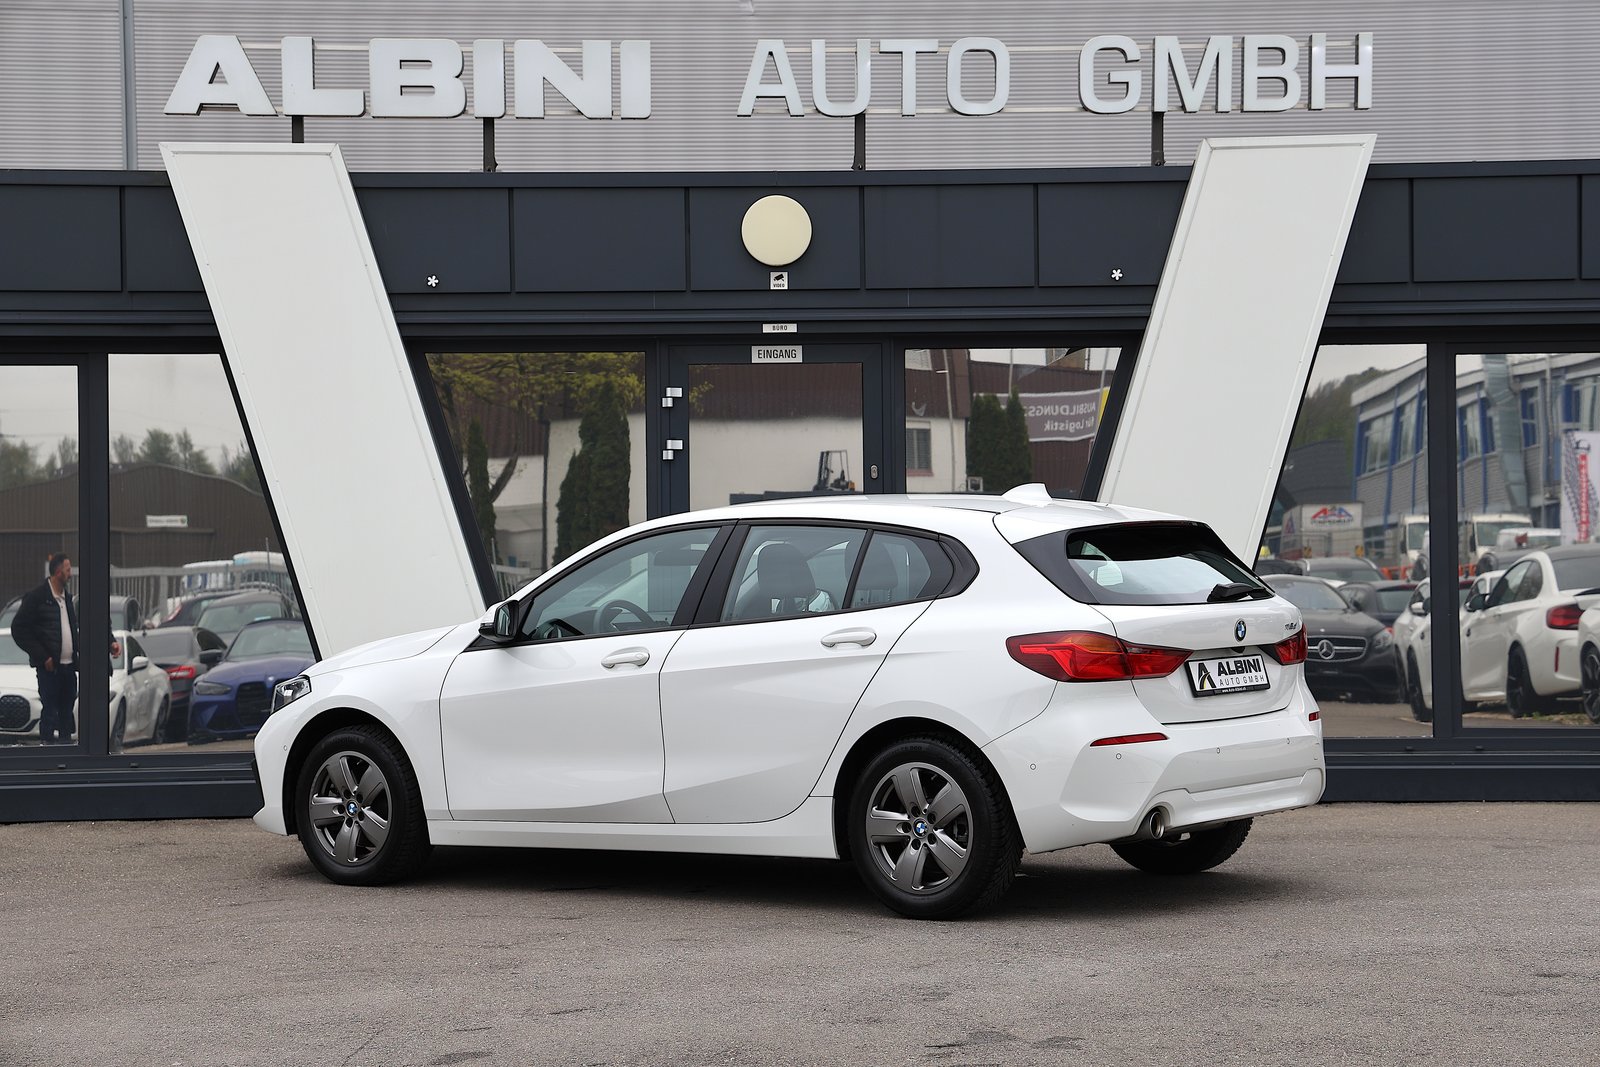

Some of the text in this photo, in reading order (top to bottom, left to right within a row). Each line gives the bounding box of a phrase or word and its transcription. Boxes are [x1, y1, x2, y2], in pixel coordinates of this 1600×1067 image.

[164, 31, 1375, 119] ALBINI AUTO GMBH
[757, 349, 797, 359] EINGANG
[1218, 658, 1262, 676] ALBINI
[1219, 674, 1265, 686] AUTO GMBH
